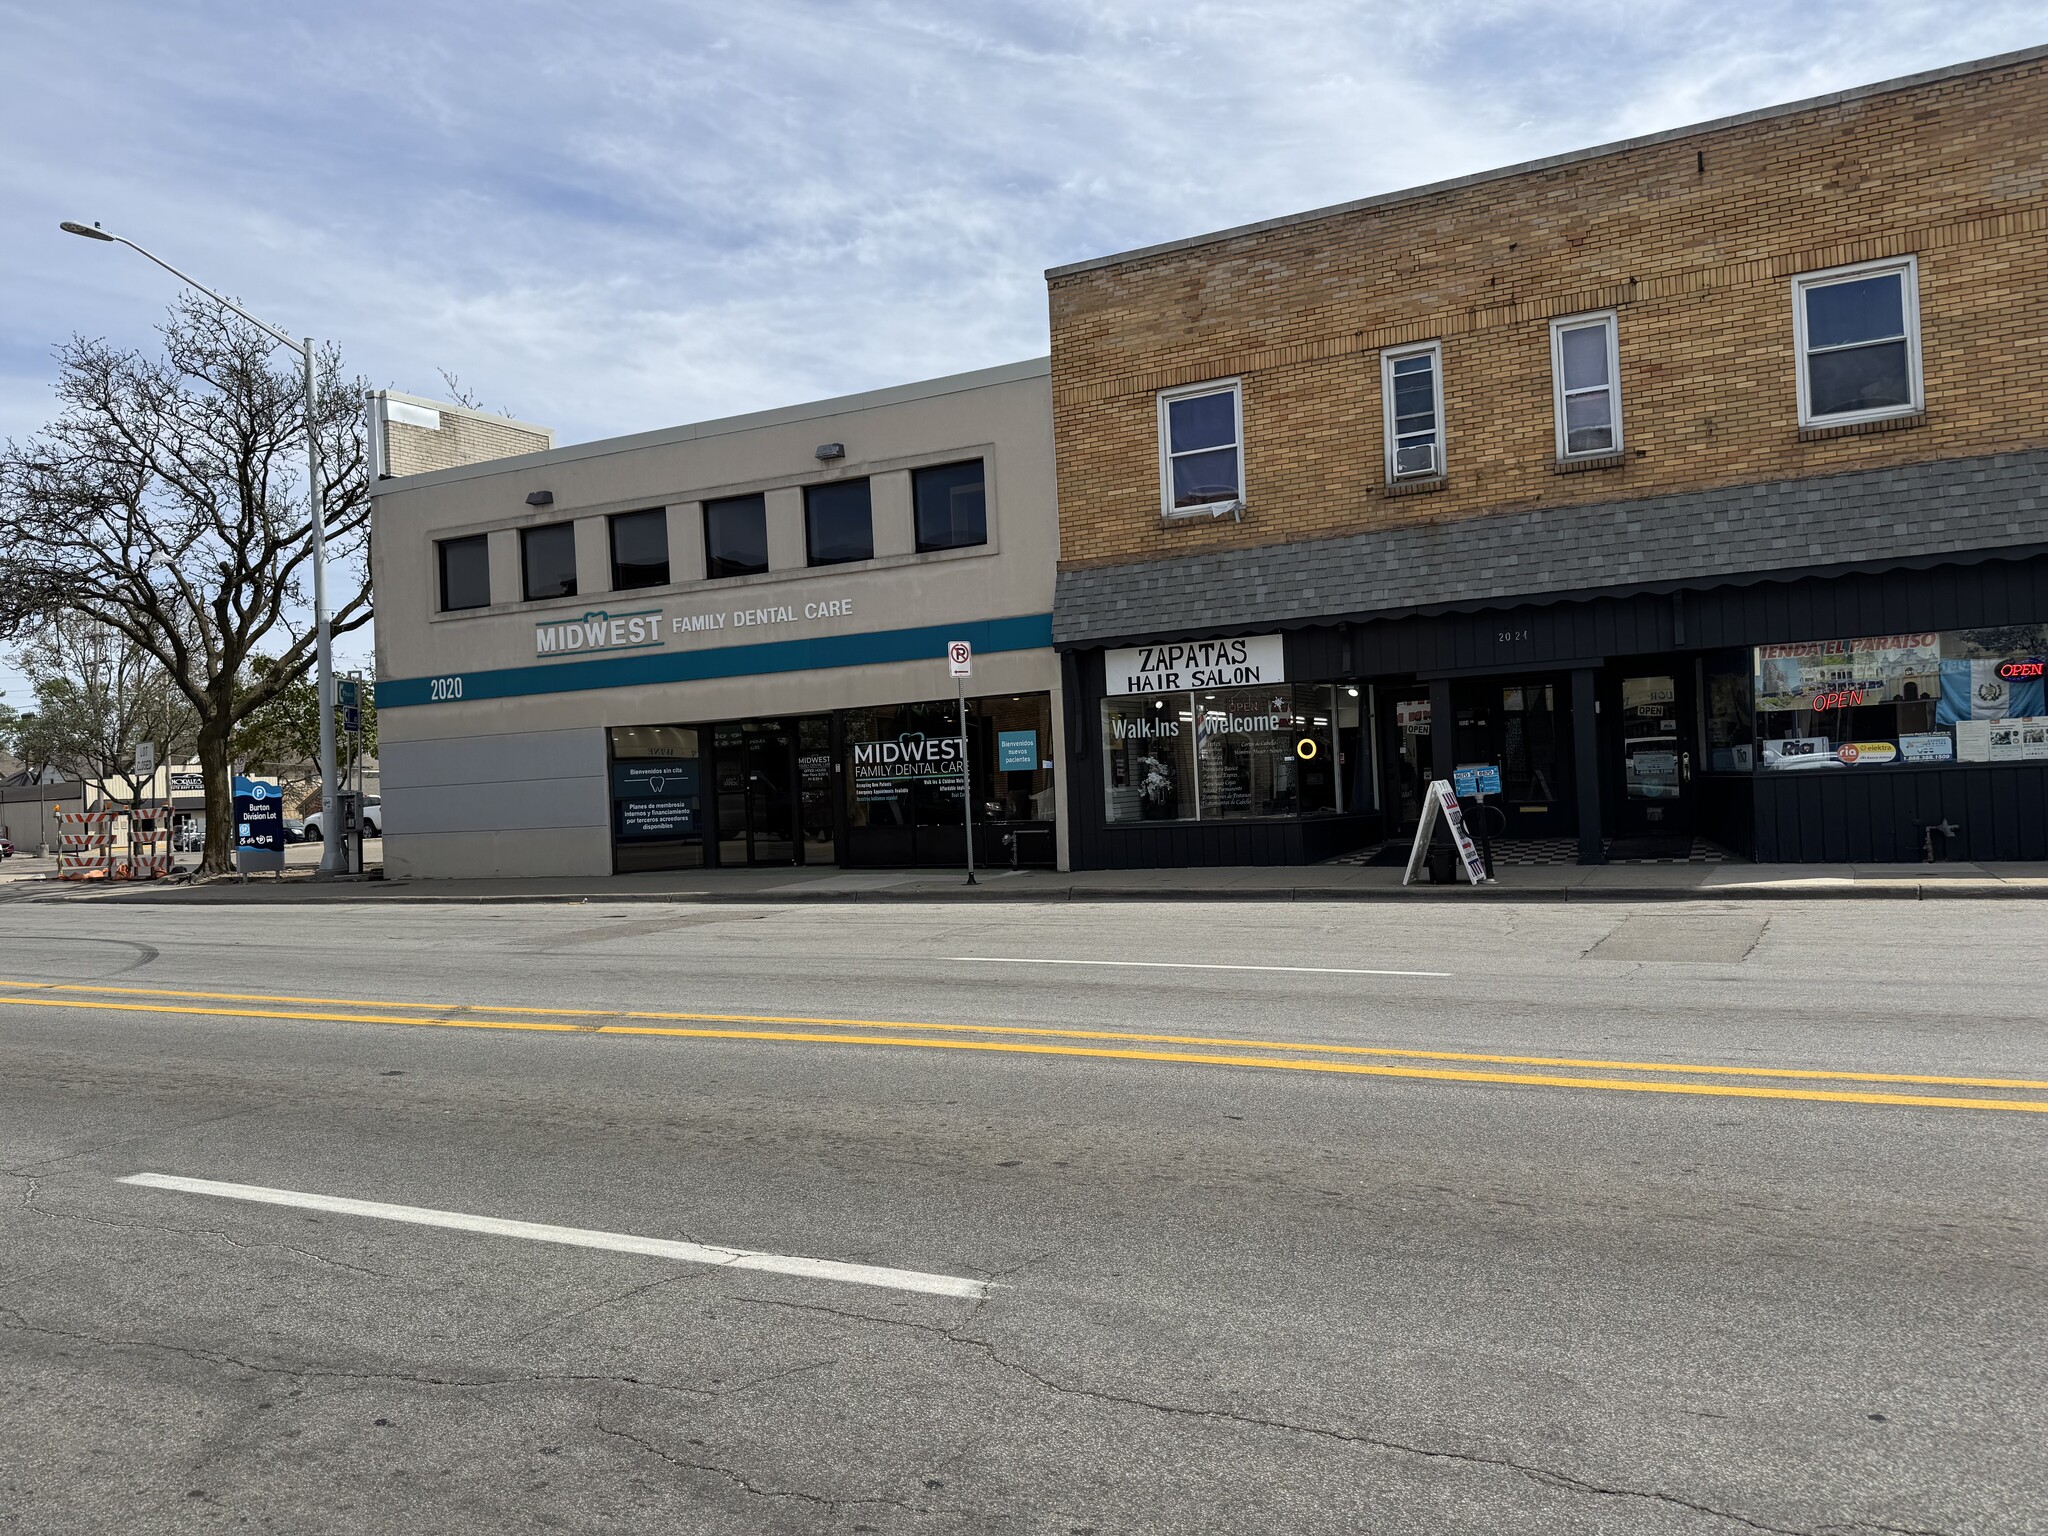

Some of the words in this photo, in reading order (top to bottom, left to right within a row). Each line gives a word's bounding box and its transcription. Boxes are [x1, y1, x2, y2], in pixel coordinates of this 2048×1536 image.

[672, 613, 726, 633] FAMILY
[733, 605, 798, 628] DENTAL
[804, 599, 853, 620] CARE
[536, 615, 663, 653] MIDWEST
[1756, 643, 1820, 659] IENDA
[1824, 641, 1844, 655] EL
[1850, 633, 1937, 653] PARAISO
[1138, 640, 1248, 673] ZAPATAS
[2000, 663, 2044, 677] OPEN
[1127, 673, 1180, 693] HAIR
[1191, 666, 1260, 688] SALON
[430, 677, 463, 700] 2020
[1229, 701, 1259, 712] OPEN
[1813, 688, 1864, 712] OPEN
[1638, 706, 1662, 715] OPEN
[1112, 717, 1180, 740] Walk-Ins
[1204, 713, 1280, 735] Welcome
[1408, 725, 1429, 734] OPEN
[855, 738, 969, 764] MIDWEST
[1001, 740, 1034, 748] Bienvenidos
[1781, 740, 1815, 756] Ria
[1839, 746, 1857, 757] ria
[798, 756, 831, 764] MIDWEST
[1005, 756, 1031, 764] pacientes
[855, 764, 892, 777] FAMILY
[895, 762, 938, 776] DENTAL
[249, 803, 270, 811] Burton
[243, 812, 267, 820] Division
[266, 811, 277, 819] Lot
